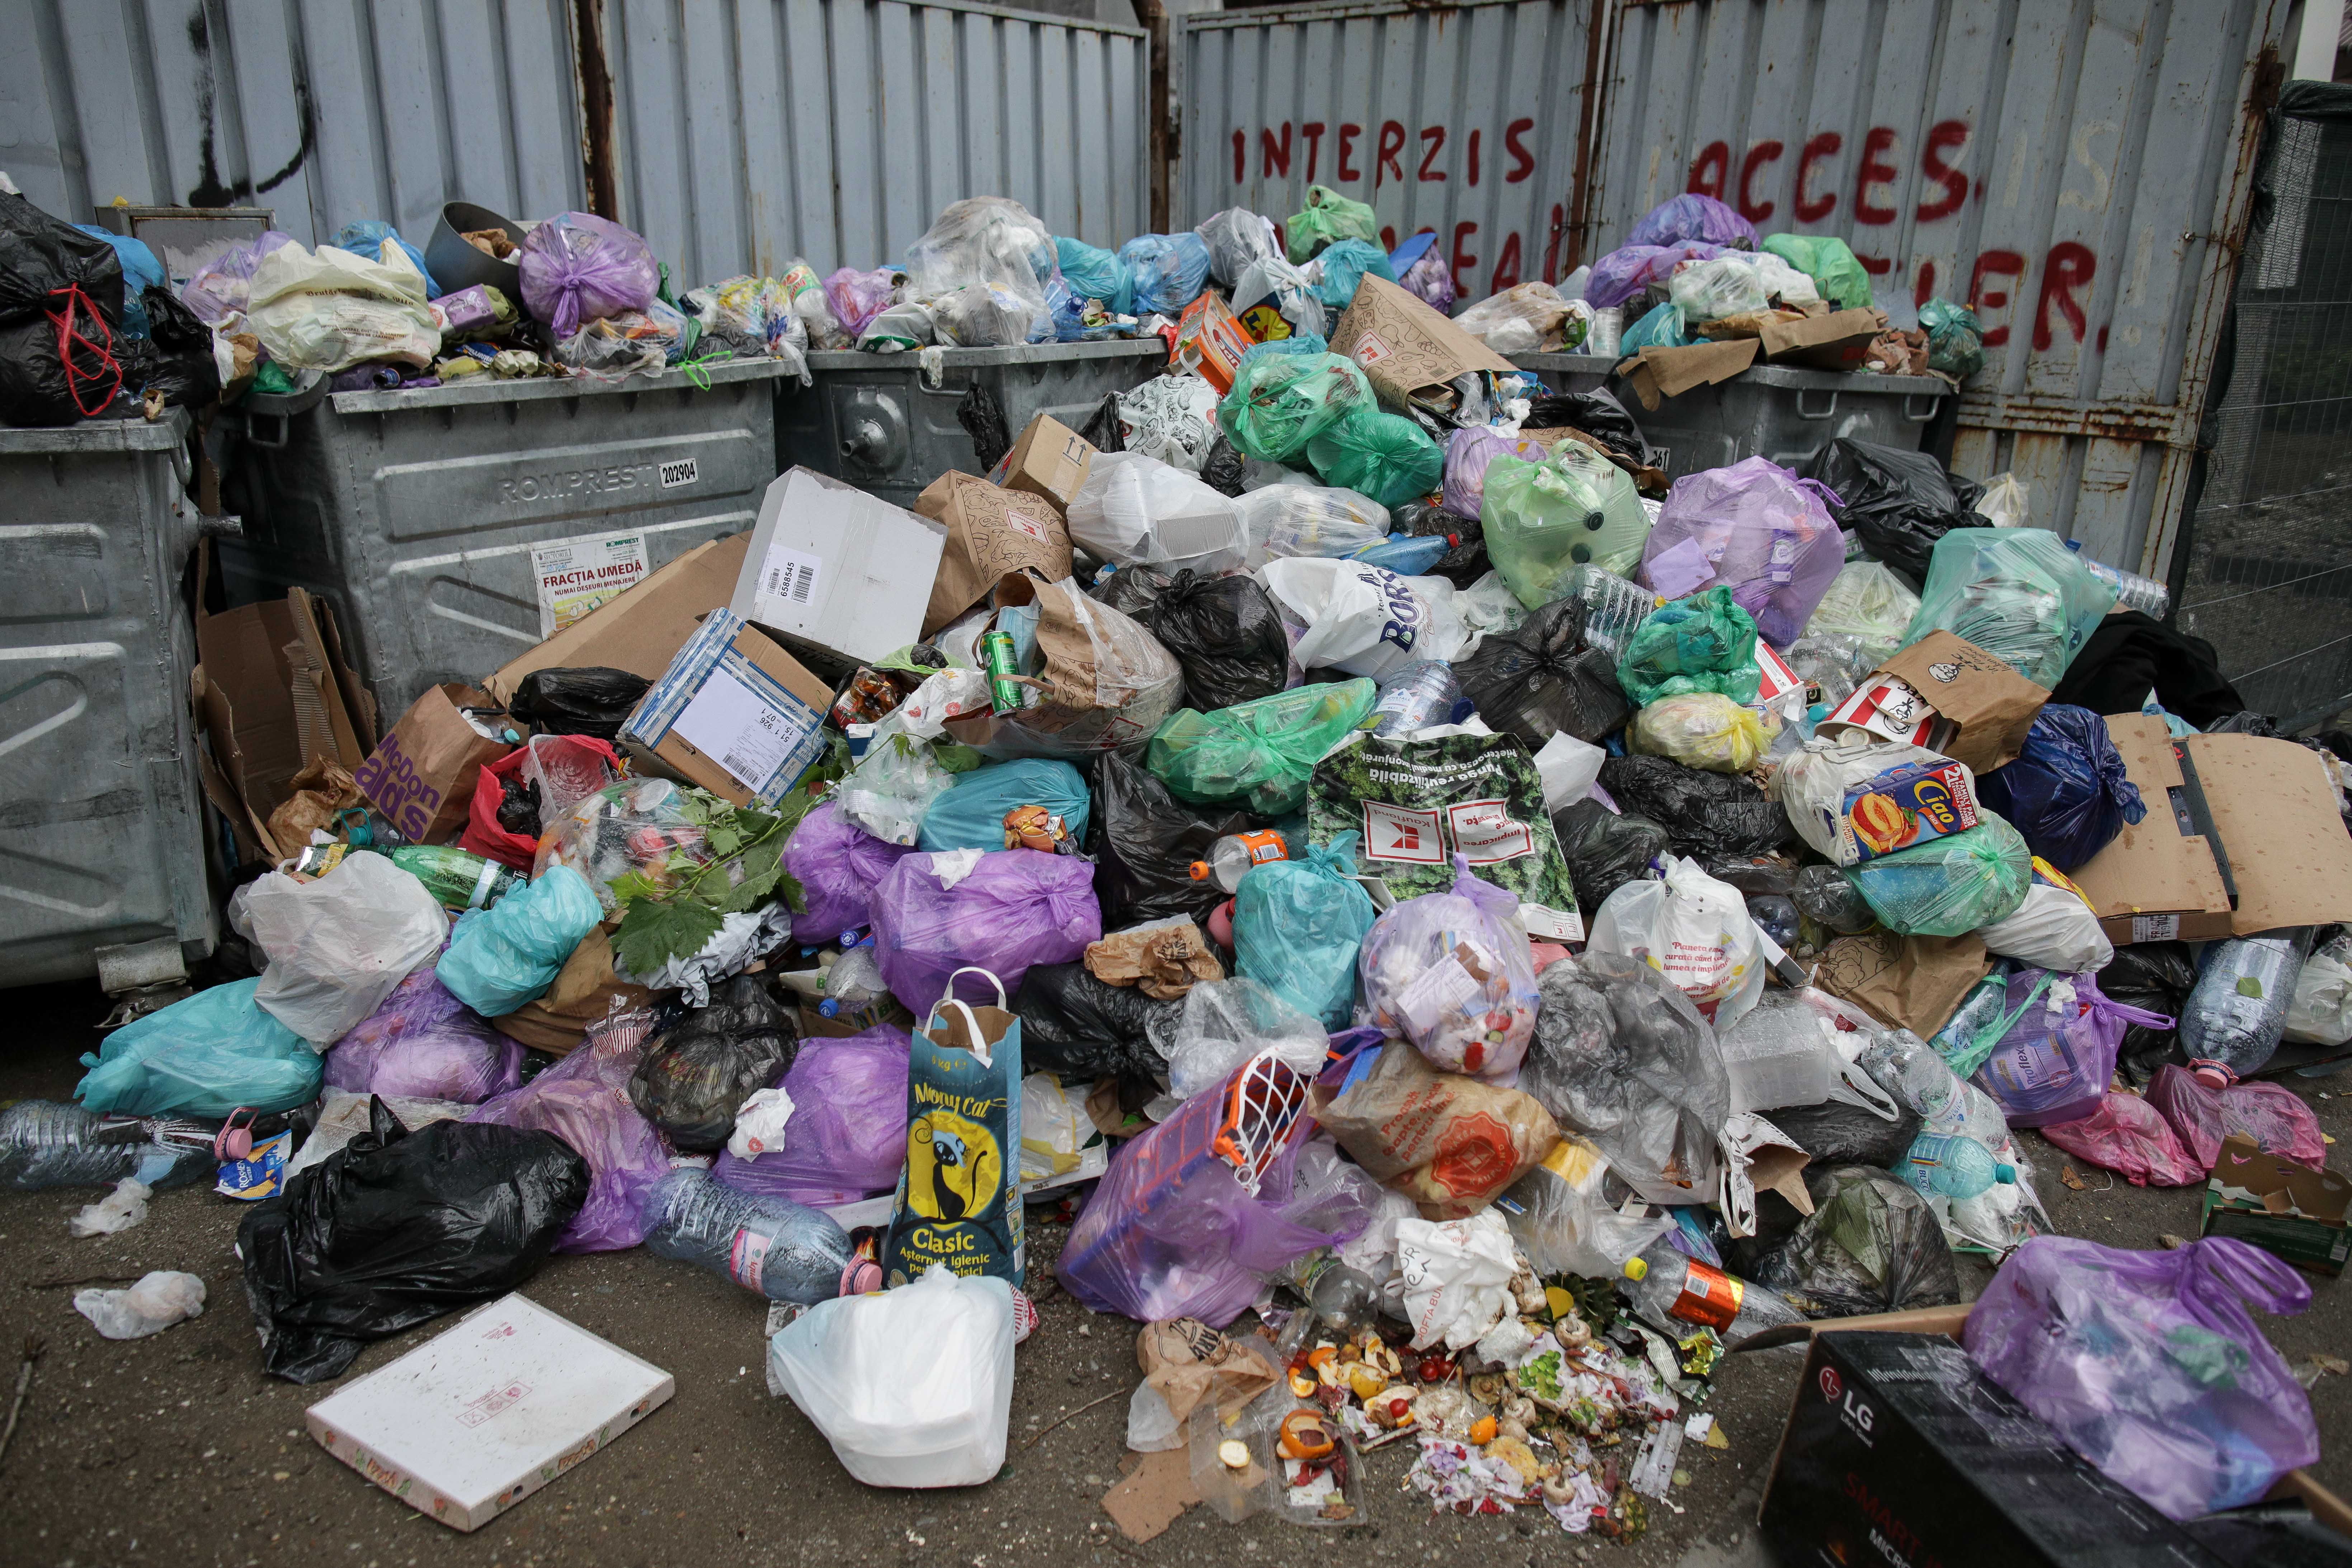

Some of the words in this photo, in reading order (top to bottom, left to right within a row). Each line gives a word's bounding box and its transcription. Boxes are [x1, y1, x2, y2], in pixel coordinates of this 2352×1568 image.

[1232, 118, 1534, 189] INTERZIS
[499, 462, 652, 504] ROMPREST
[663, 462, 696, 484] 202904
[1011, 514, 1040, 530] Kaufland
[606, 537, 639, 547] ROMPREST
[543, 569, 595, 588] FRACȚIA
[597, 559, 642, 578] UMEDĂ
[781, 561, 795, 597] 6588545
[555, 587, 576, 596] NUMAI
[604, 576, 636, 587] MENAJERE
[1951, 654, 1983, 672] KFC
[758, 716, 774, 730] 926
[766, 711, 777, 722] 07
[377, 732, 440, 811] McDon
[1411, 763, 1442, 772] mediul
[1457, 763, 1504, 781] Pungă
[1943, 765, 1961, 788] 2L
[1369, 768, 1455, 789] reutilizabilă
[354, 757, 429, 840] ald's
[1955, 780, 1963, 801] PACHET
[1914, 780, 1955, 824] Ciao
[1958, 779, 1971, 806] FAMILY
[1967, 805, 1977, 826] PACK
[1960, 800, 1965, 808] DE
[1373, 808, 1430, 828] Kaufland
[1928, 814, 1939, 825] PEACH
[1962, 806, 1972, 827] FAMILIE
[1463, 829, 1521, 846] Implicarea
[1842, 816, 1854, 843] VITAMINA
[1672, 942, 1707, 952] Planeta
[1721, 976, 1730, 984] de
[938, 1059, 951, 1072] kg
[963, 1097, 995, 1118] Cat
[236, 1159, 250, 1188] ROSHEN
[913, 1228, 975, 1254] Clasic
[1843, 1389, 1874, 1432] LG
[1846, 1472, 1923, 1560] SMART
